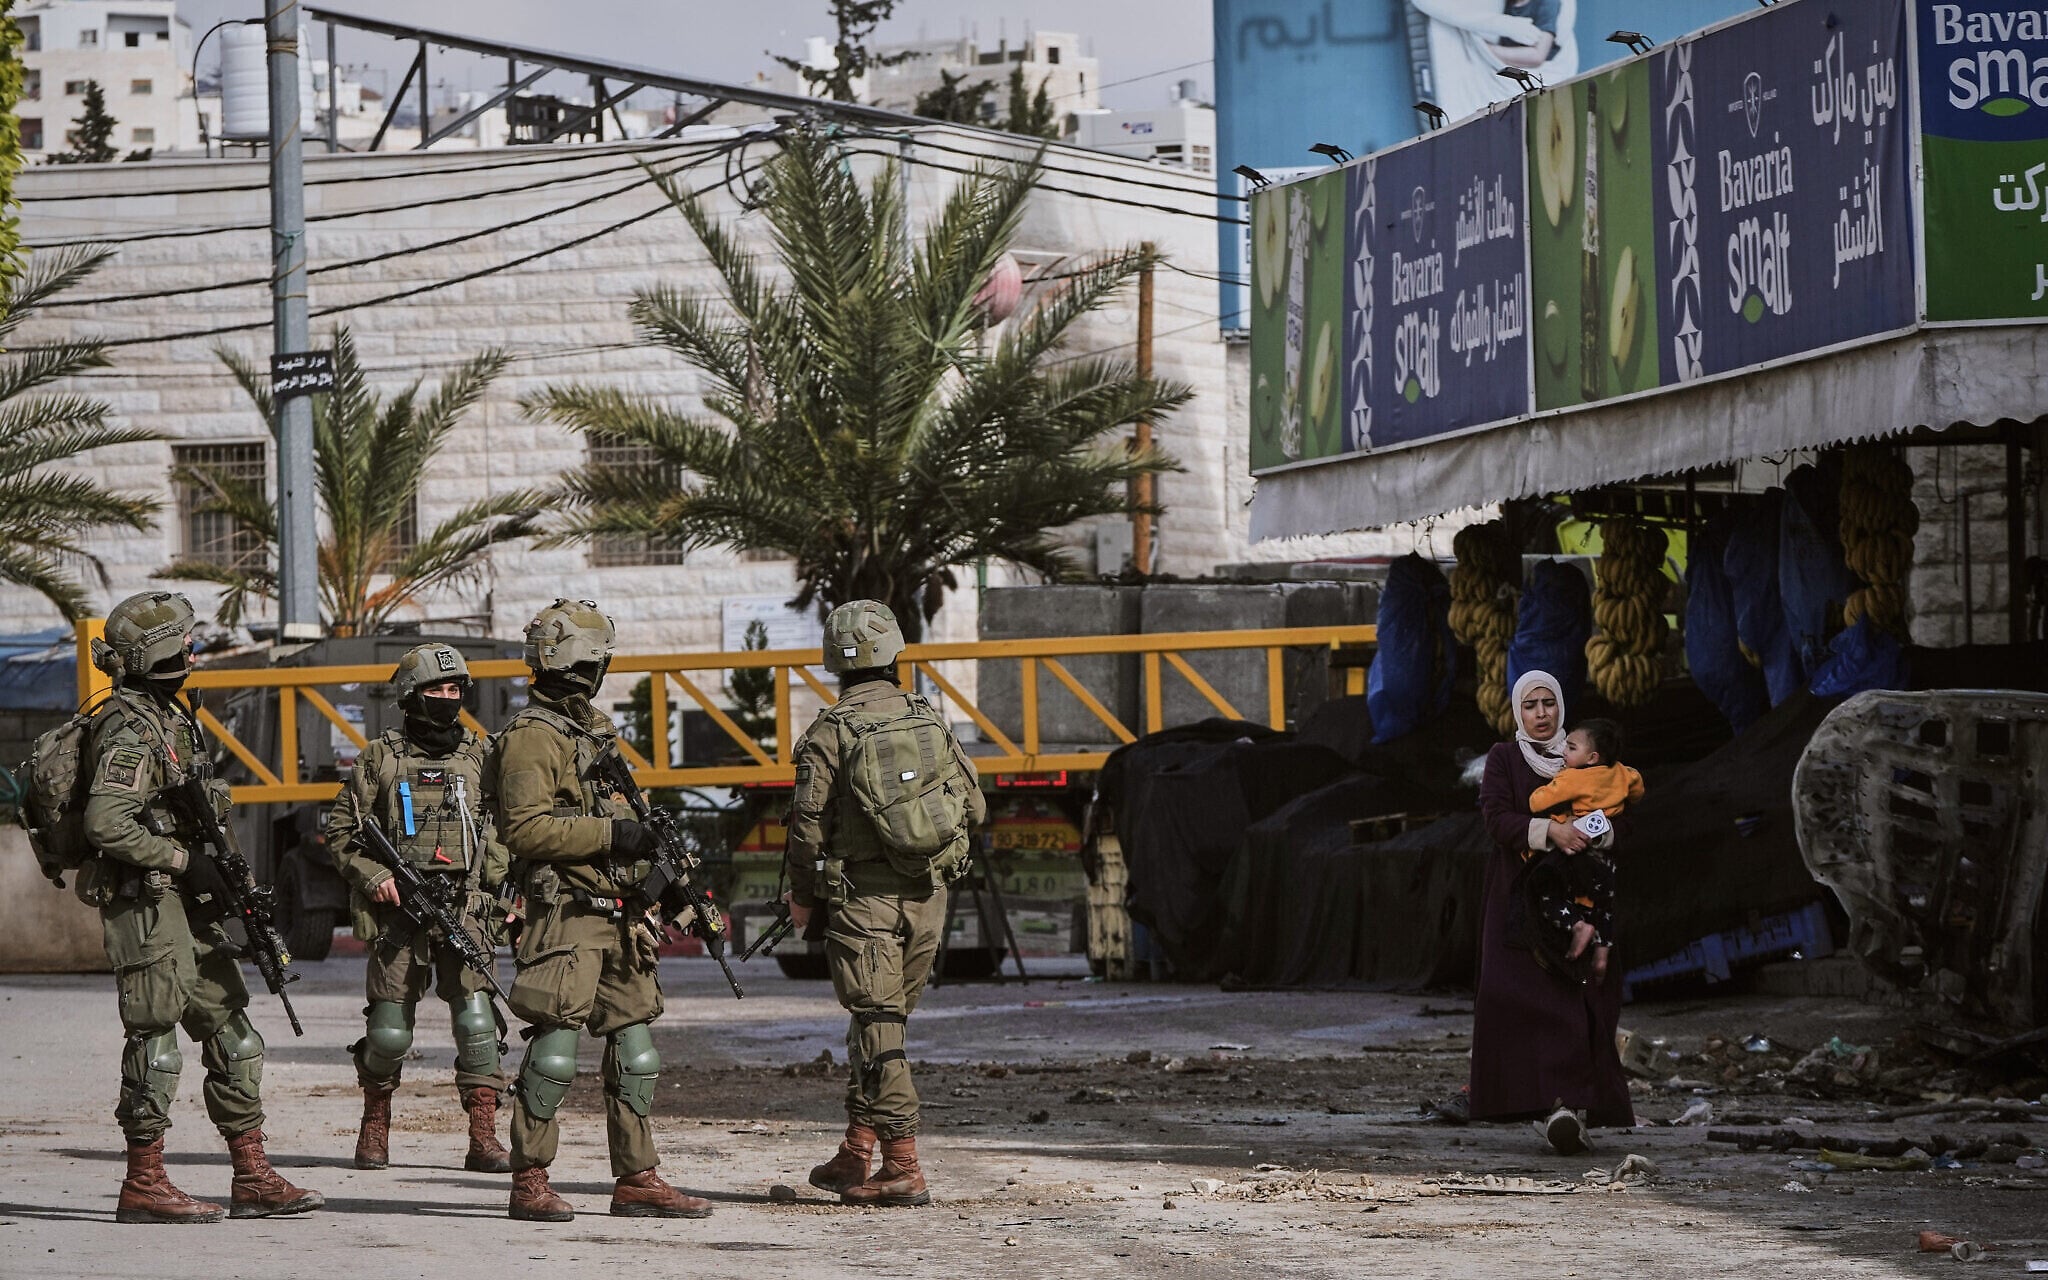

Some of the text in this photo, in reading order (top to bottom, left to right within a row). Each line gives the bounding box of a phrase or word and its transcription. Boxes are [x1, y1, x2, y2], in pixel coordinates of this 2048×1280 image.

[1811, 31, 1856, 145] ماركت
[1718, 131, 1794, 212] Bavaria
[1454, 174, 1515, 268] محلات الأشقر
[1727, 211, 1792, 315] smalt
[1833, 157, 1884, 289] الأشقر
[1392, 238, 1444, 306] Bavaria
[1492, 272, 1523, 361] للخضار
[1394, 308, 1441, 398] smalt
